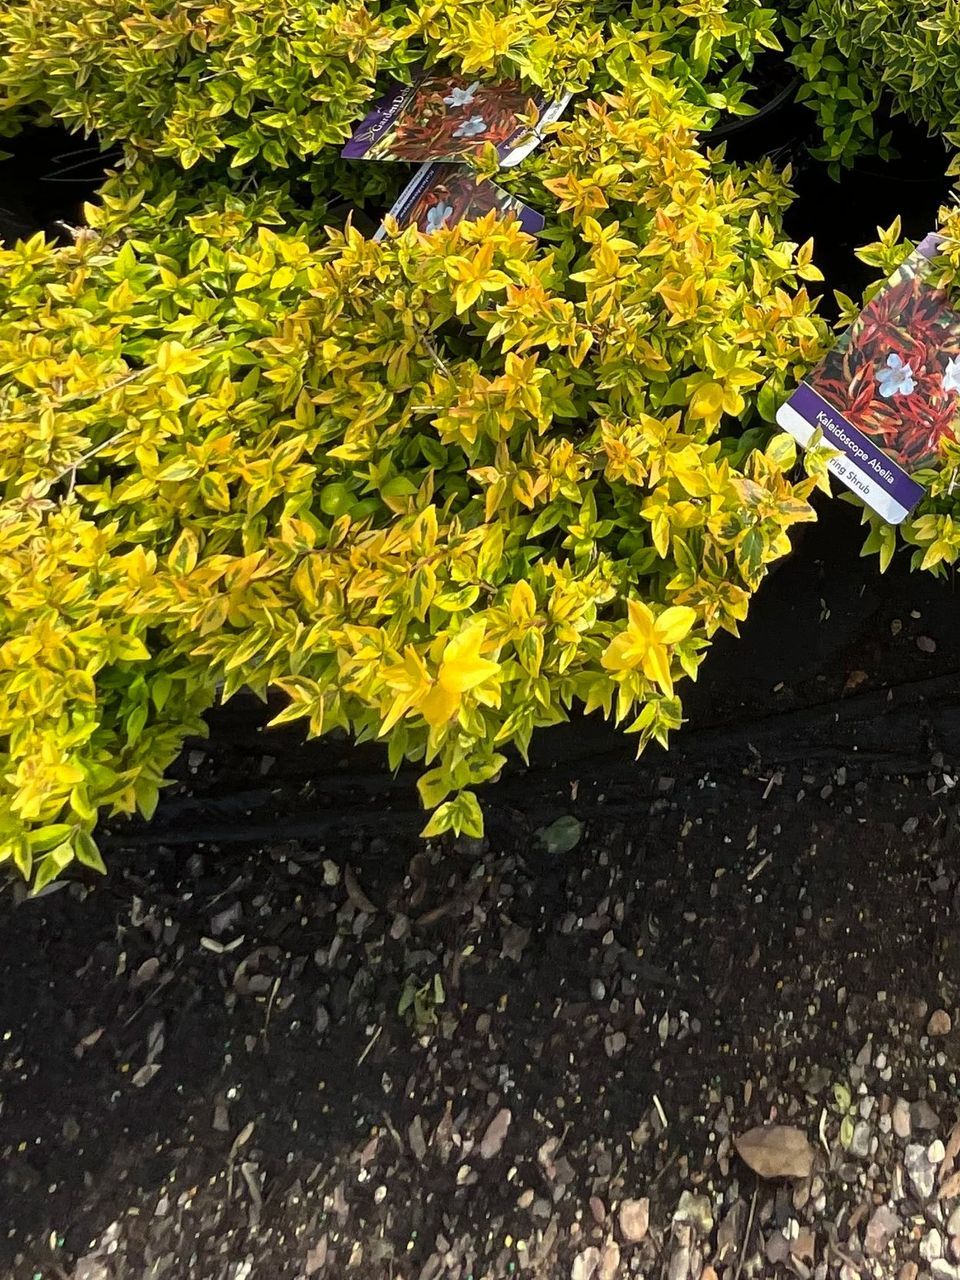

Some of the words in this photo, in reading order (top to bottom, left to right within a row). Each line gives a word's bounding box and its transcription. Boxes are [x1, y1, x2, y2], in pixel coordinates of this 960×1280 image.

[372, 104, 399, 131] Garden
[816, 410, 869, 461] Kaleidoscope
[868, 458, 895, 484] Abelia
[846, 470, 870, 495] Shrub
